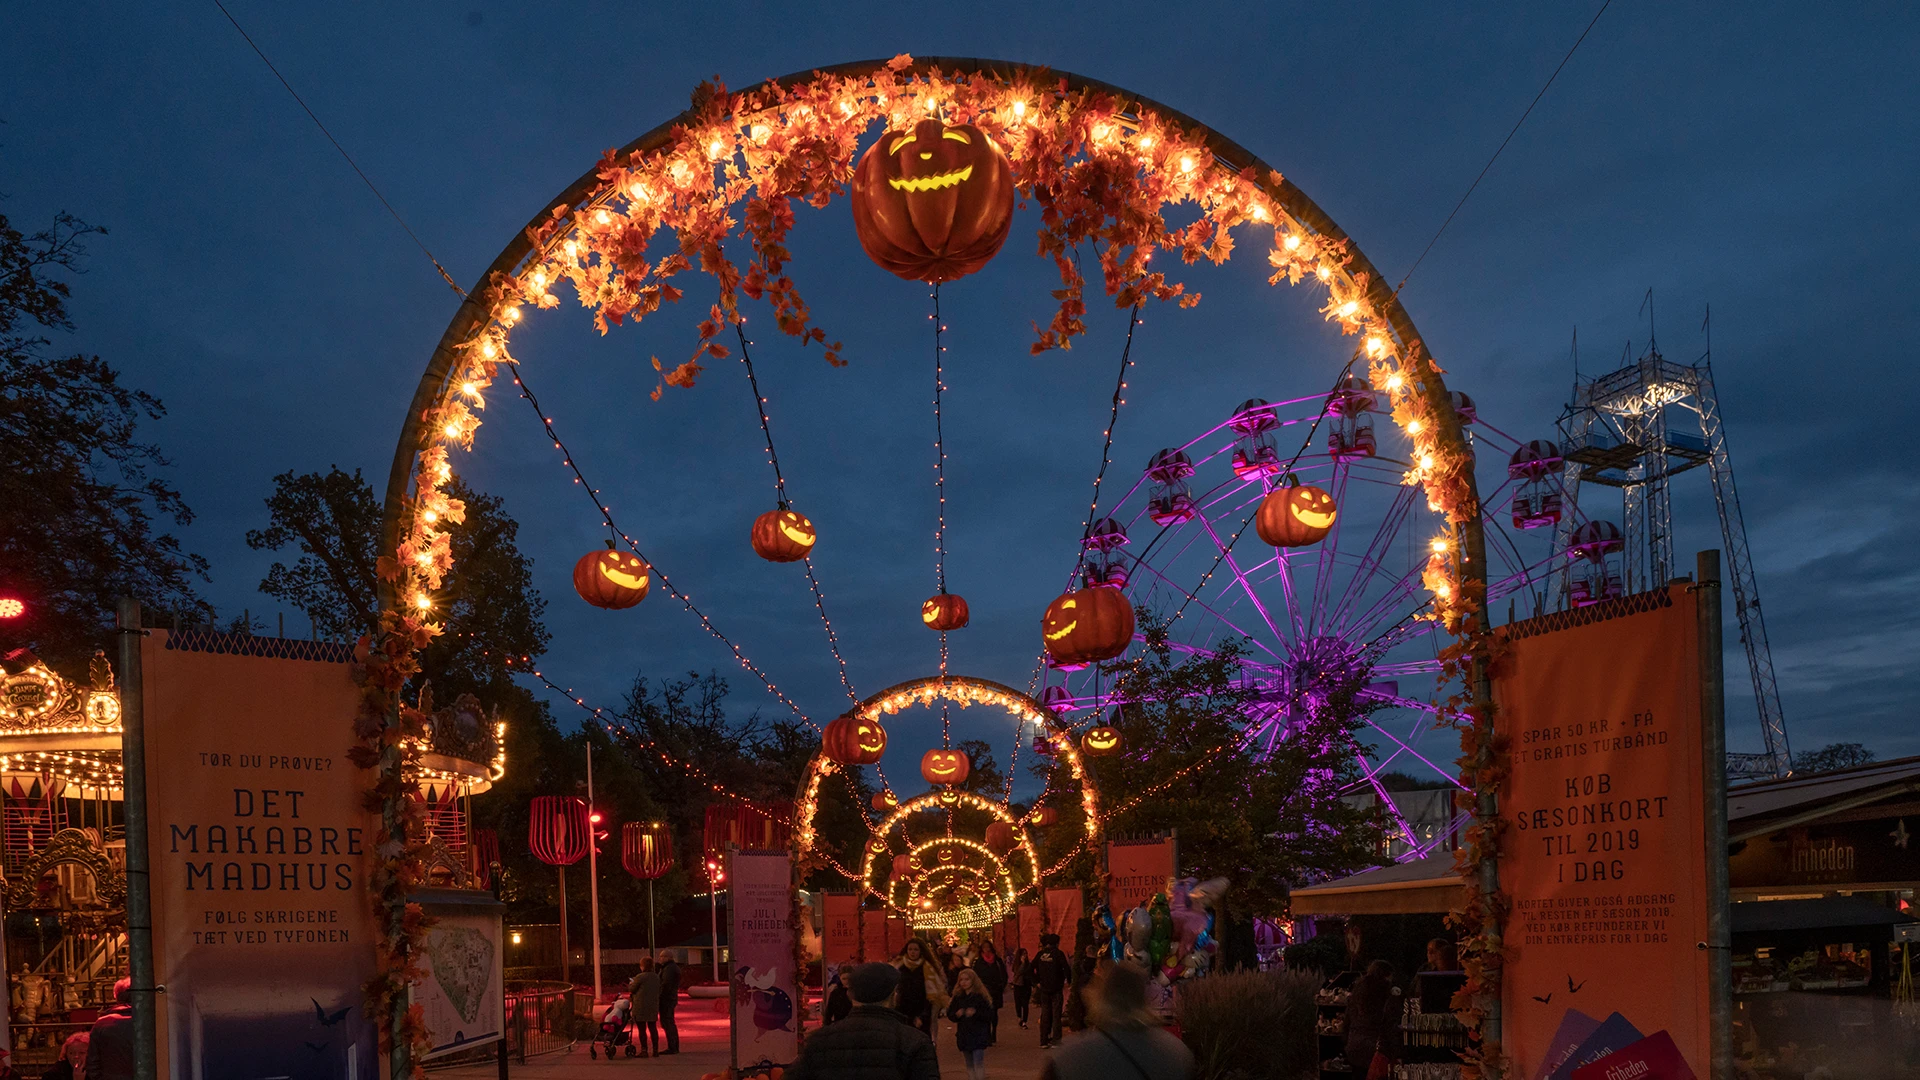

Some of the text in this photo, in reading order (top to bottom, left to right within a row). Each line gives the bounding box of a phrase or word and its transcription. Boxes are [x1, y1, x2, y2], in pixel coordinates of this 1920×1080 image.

[1523, 709, 1654, 744] SPAR 50 KR. FÅ
[1514, 730, 1668, 765] ET GRATIS TURBÅND
[200, 753, 332, 771] TØR DU PRØVE?
[1565, 773, 1611, 798] KØB
[233, 788, 304, 818] DET
[1518, 796, 1668, 830] SÆSONKORT
[169, 824, 363, 855] MAKABRE
[1542, 829, 1639, 857] TIL 2019
[186, 862, 352, 891] MADHUS
[1558, 859, 1624, 883] I DAG
[1115, 875, 1165, 887] NATTENS
[1123, 887, 1158, 898] TIVOI
[1517, 893, 1676, 910] KORTET GIVER OGSÅ ADGANG
[204, 910, 338, 924] FØLG SKRIGENE
[753, 909, 770, 918] JUL
[1522, 907, 1674, 921] TIL RESTEN AF SÆSON 2018.
[742, 920, 788, 930] FRIHEDEN
[1526, 920, 1665, 933] VED KØB REFUNDERER VI
[193, 929, 349, 945] TÆT VED TYFONEN
[1525, 935, 1543, 945] DIN
[1610, 933, 1631, 944] FOR
[1644, 933, 1668, 943] DAG
[1606, 1060, 1649, 1080] friheden
